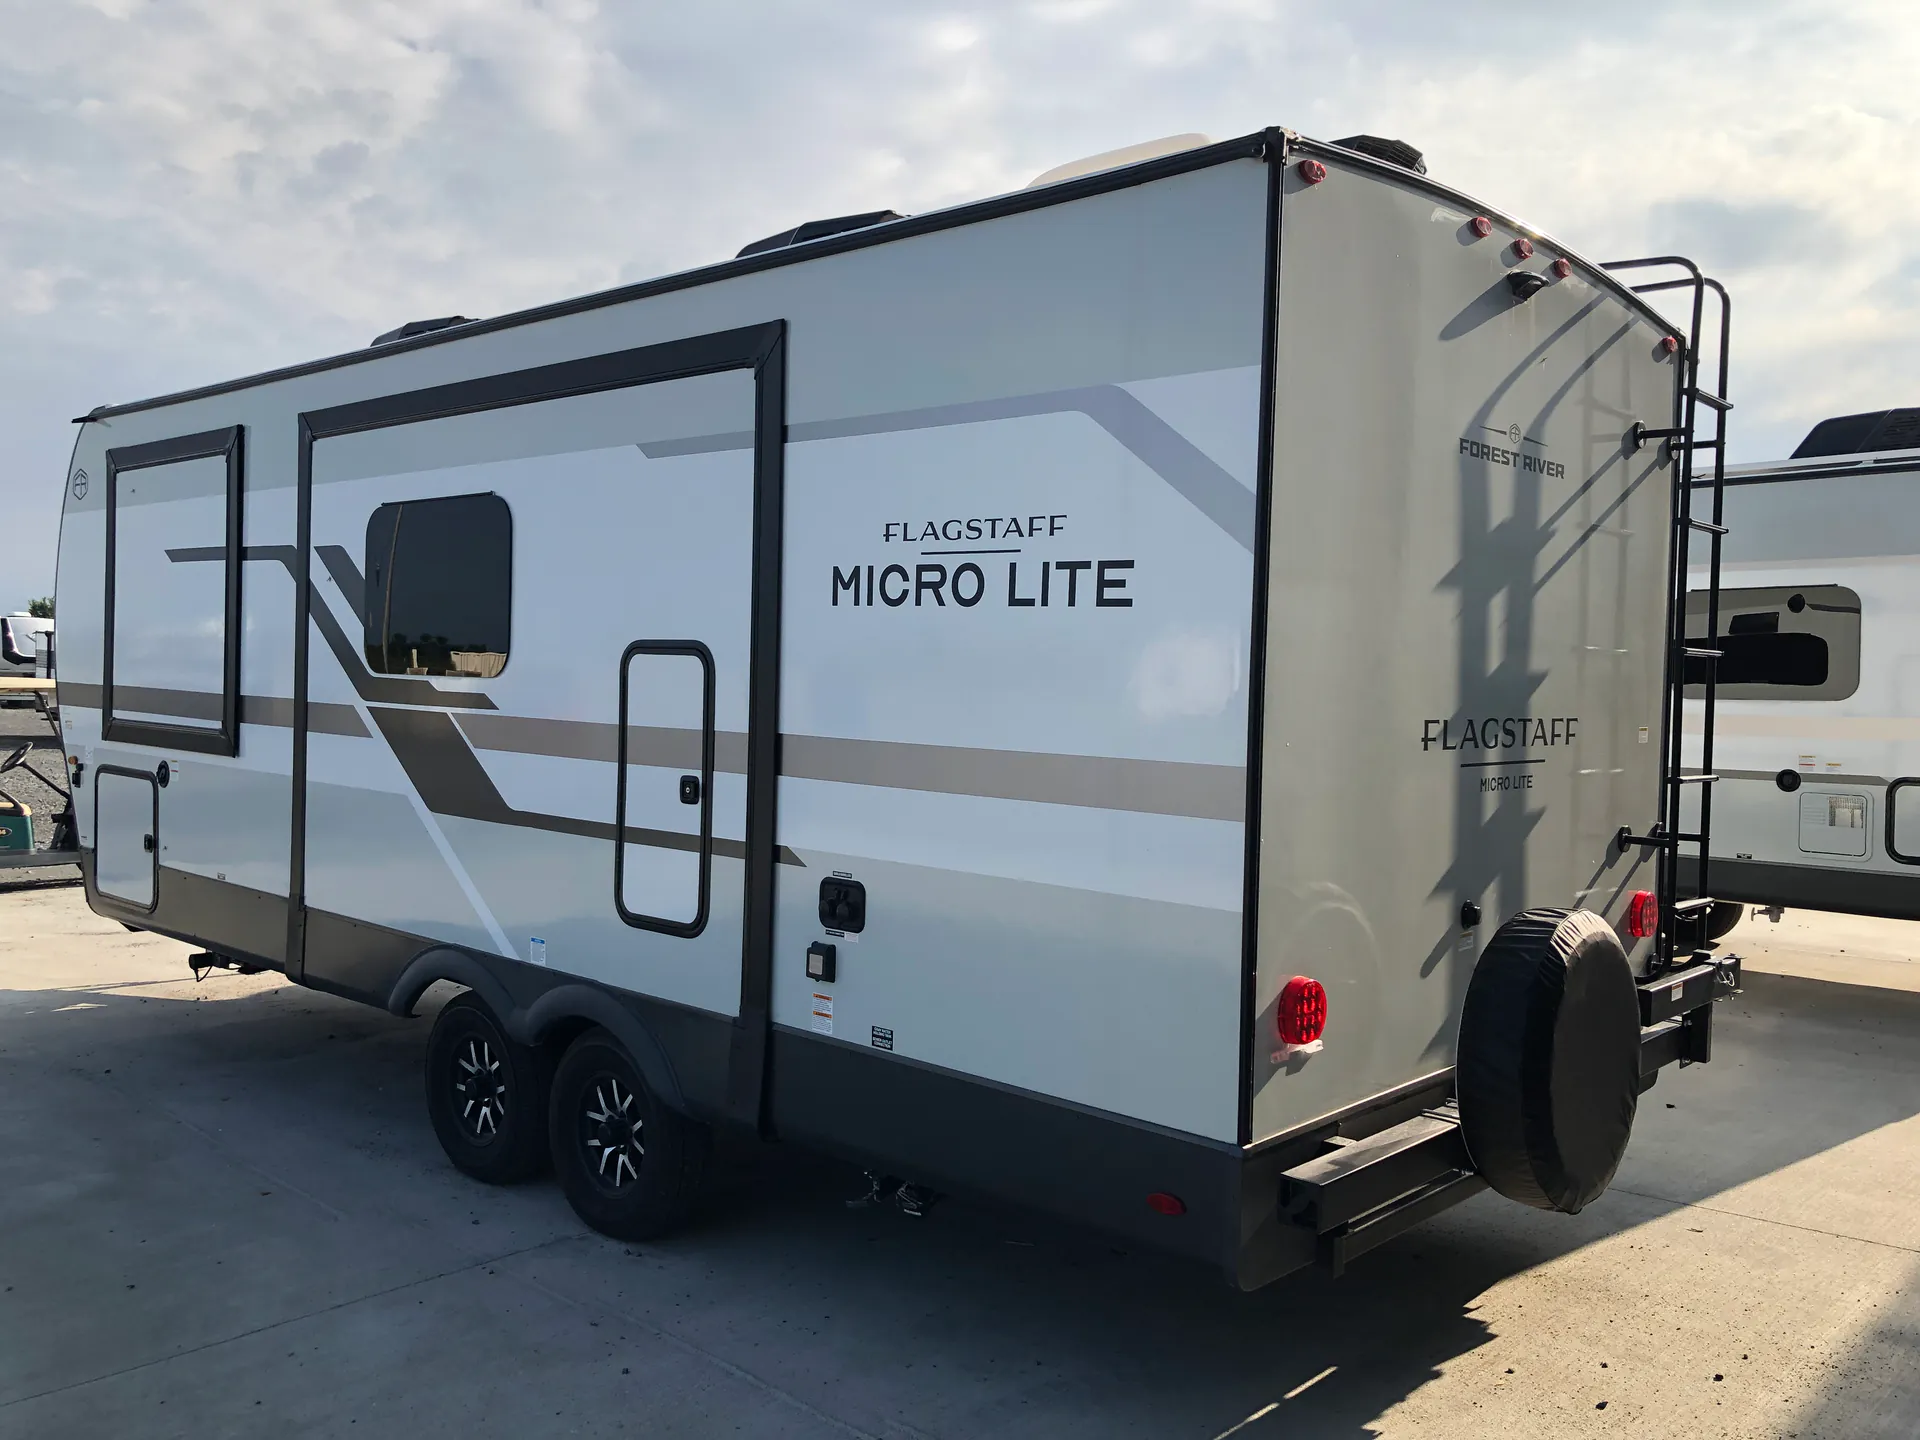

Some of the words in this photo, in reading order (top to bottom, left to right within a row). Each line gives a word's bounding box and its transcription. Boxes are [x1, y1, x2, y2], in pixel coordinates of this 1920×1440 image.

[1459, 437, 1520, 468] FOREST
[1523, 454, 1565, 480] RIVER
[883, 514, 1067, 543] FLAGSTAFF
[831, 562, 986, 608] MICRO
[1007, 559, 1135, 608] LITE
[1421, 717, 1579, 752] FLAGSTAFF
[1480, 775, 1511, 793] MICRO
[1513, 774, 1534, 790] LITE
